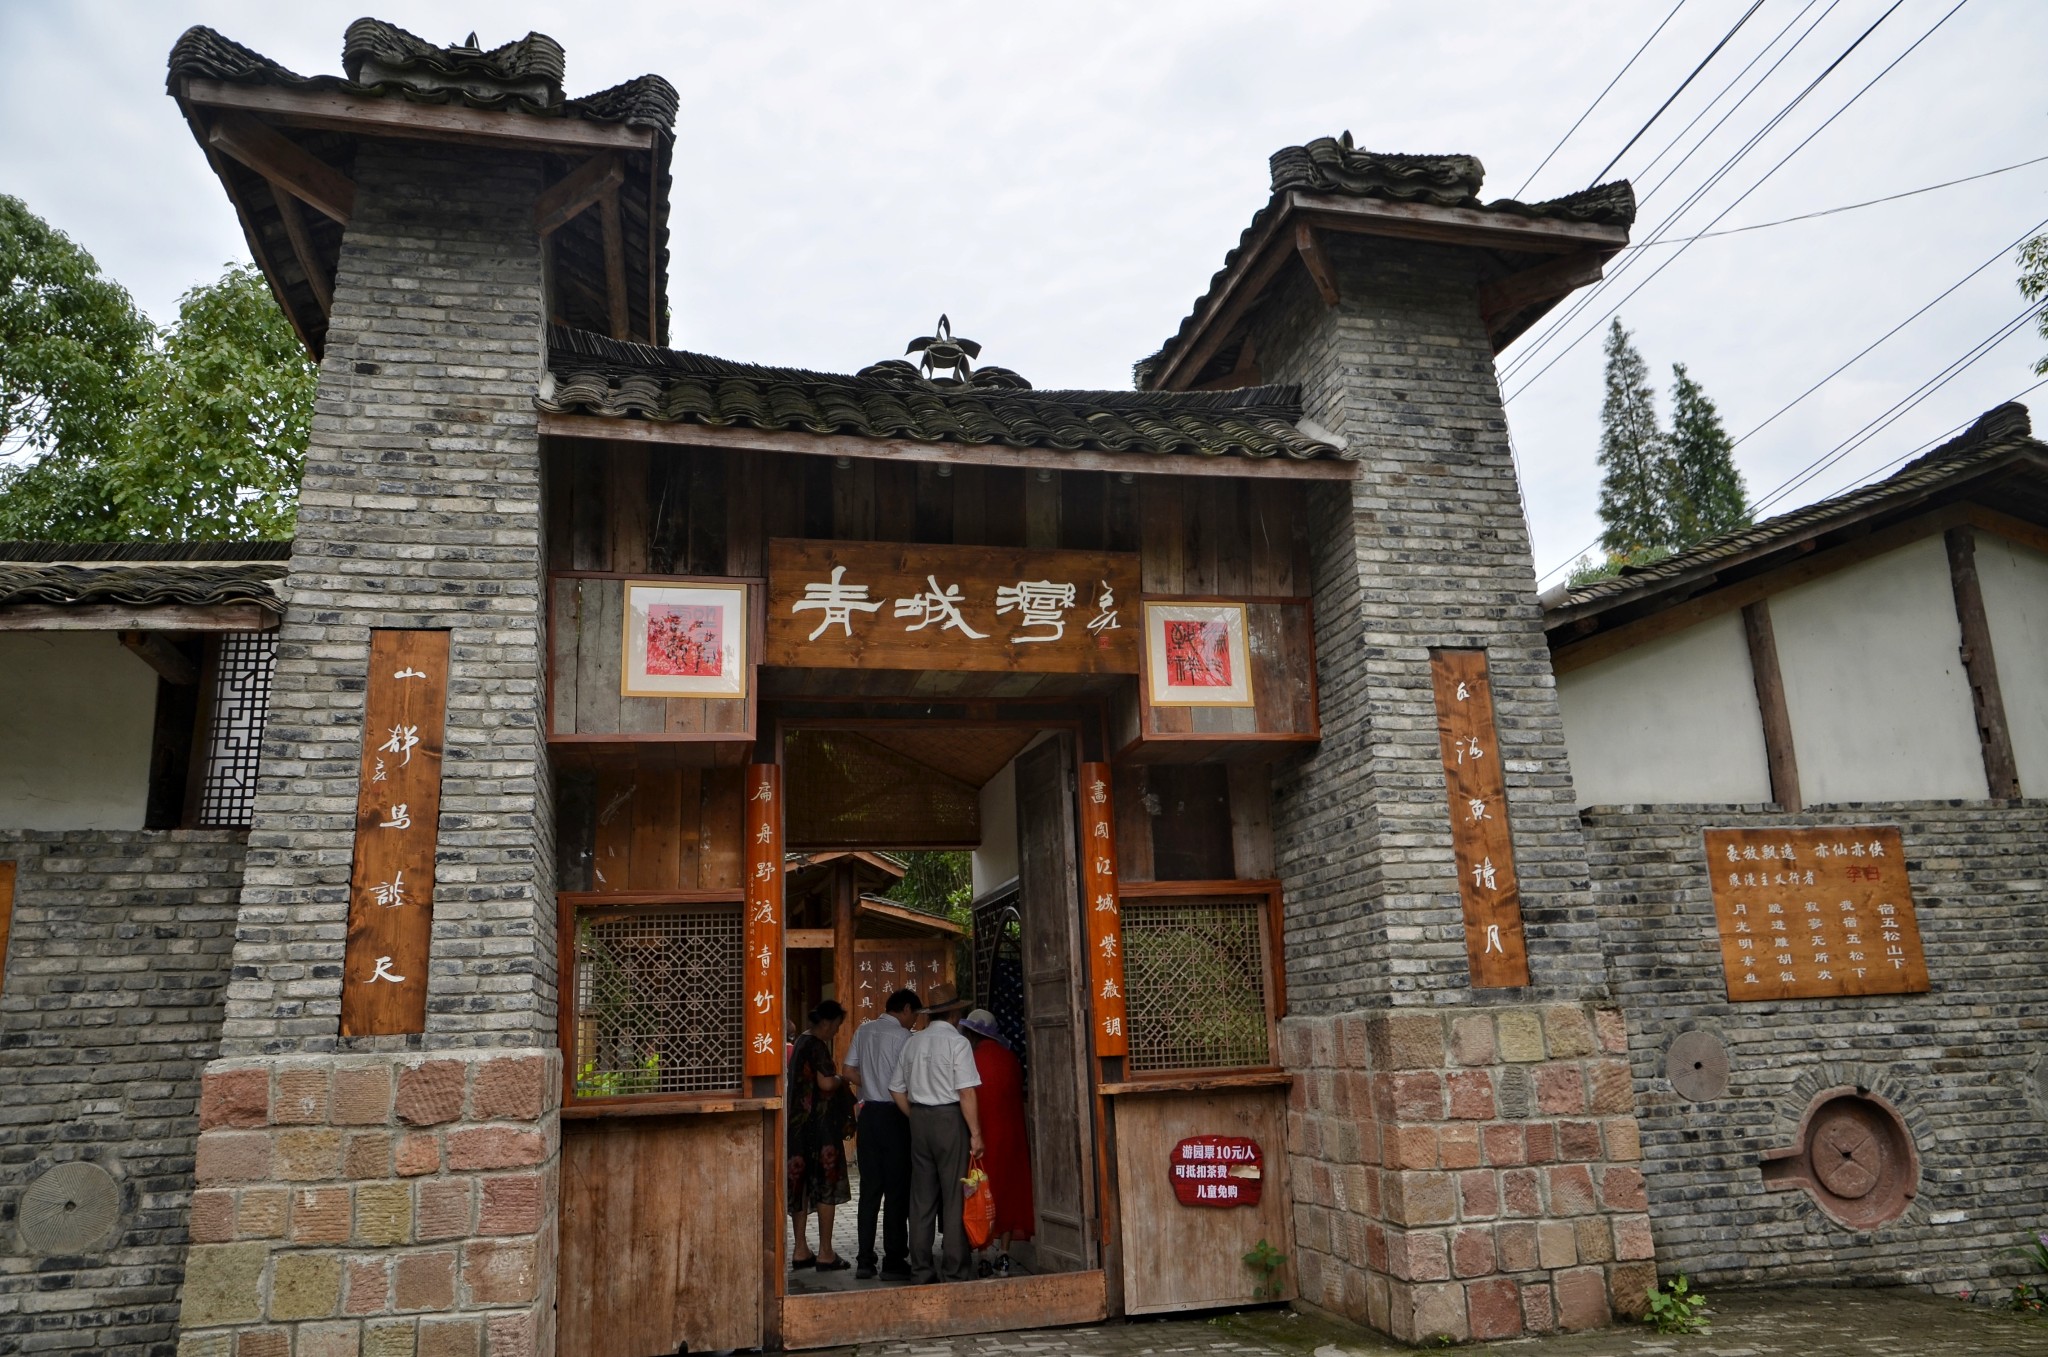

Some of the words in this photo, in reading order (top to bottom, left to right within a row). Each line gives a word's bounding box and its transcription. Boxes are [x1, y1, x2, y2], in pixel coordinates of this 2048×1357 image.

[1814, 840, 1885, 859] 亦仙亦侠
[1728, 870, 1815, 887] 浪漫主义行者
[1846, 864, 1881, 883] 李白
[1839, 900, 1867, 978] 我宿五松下
[1877, 903, 1905, 969] 宿五松山下
[1182, 1145, 1255, 1160] 游园票10元/人
[1175, 1165, 1227, 1179] 可抵扣茶费
[1196, 1184, 1238, 1199] 儿童免购
